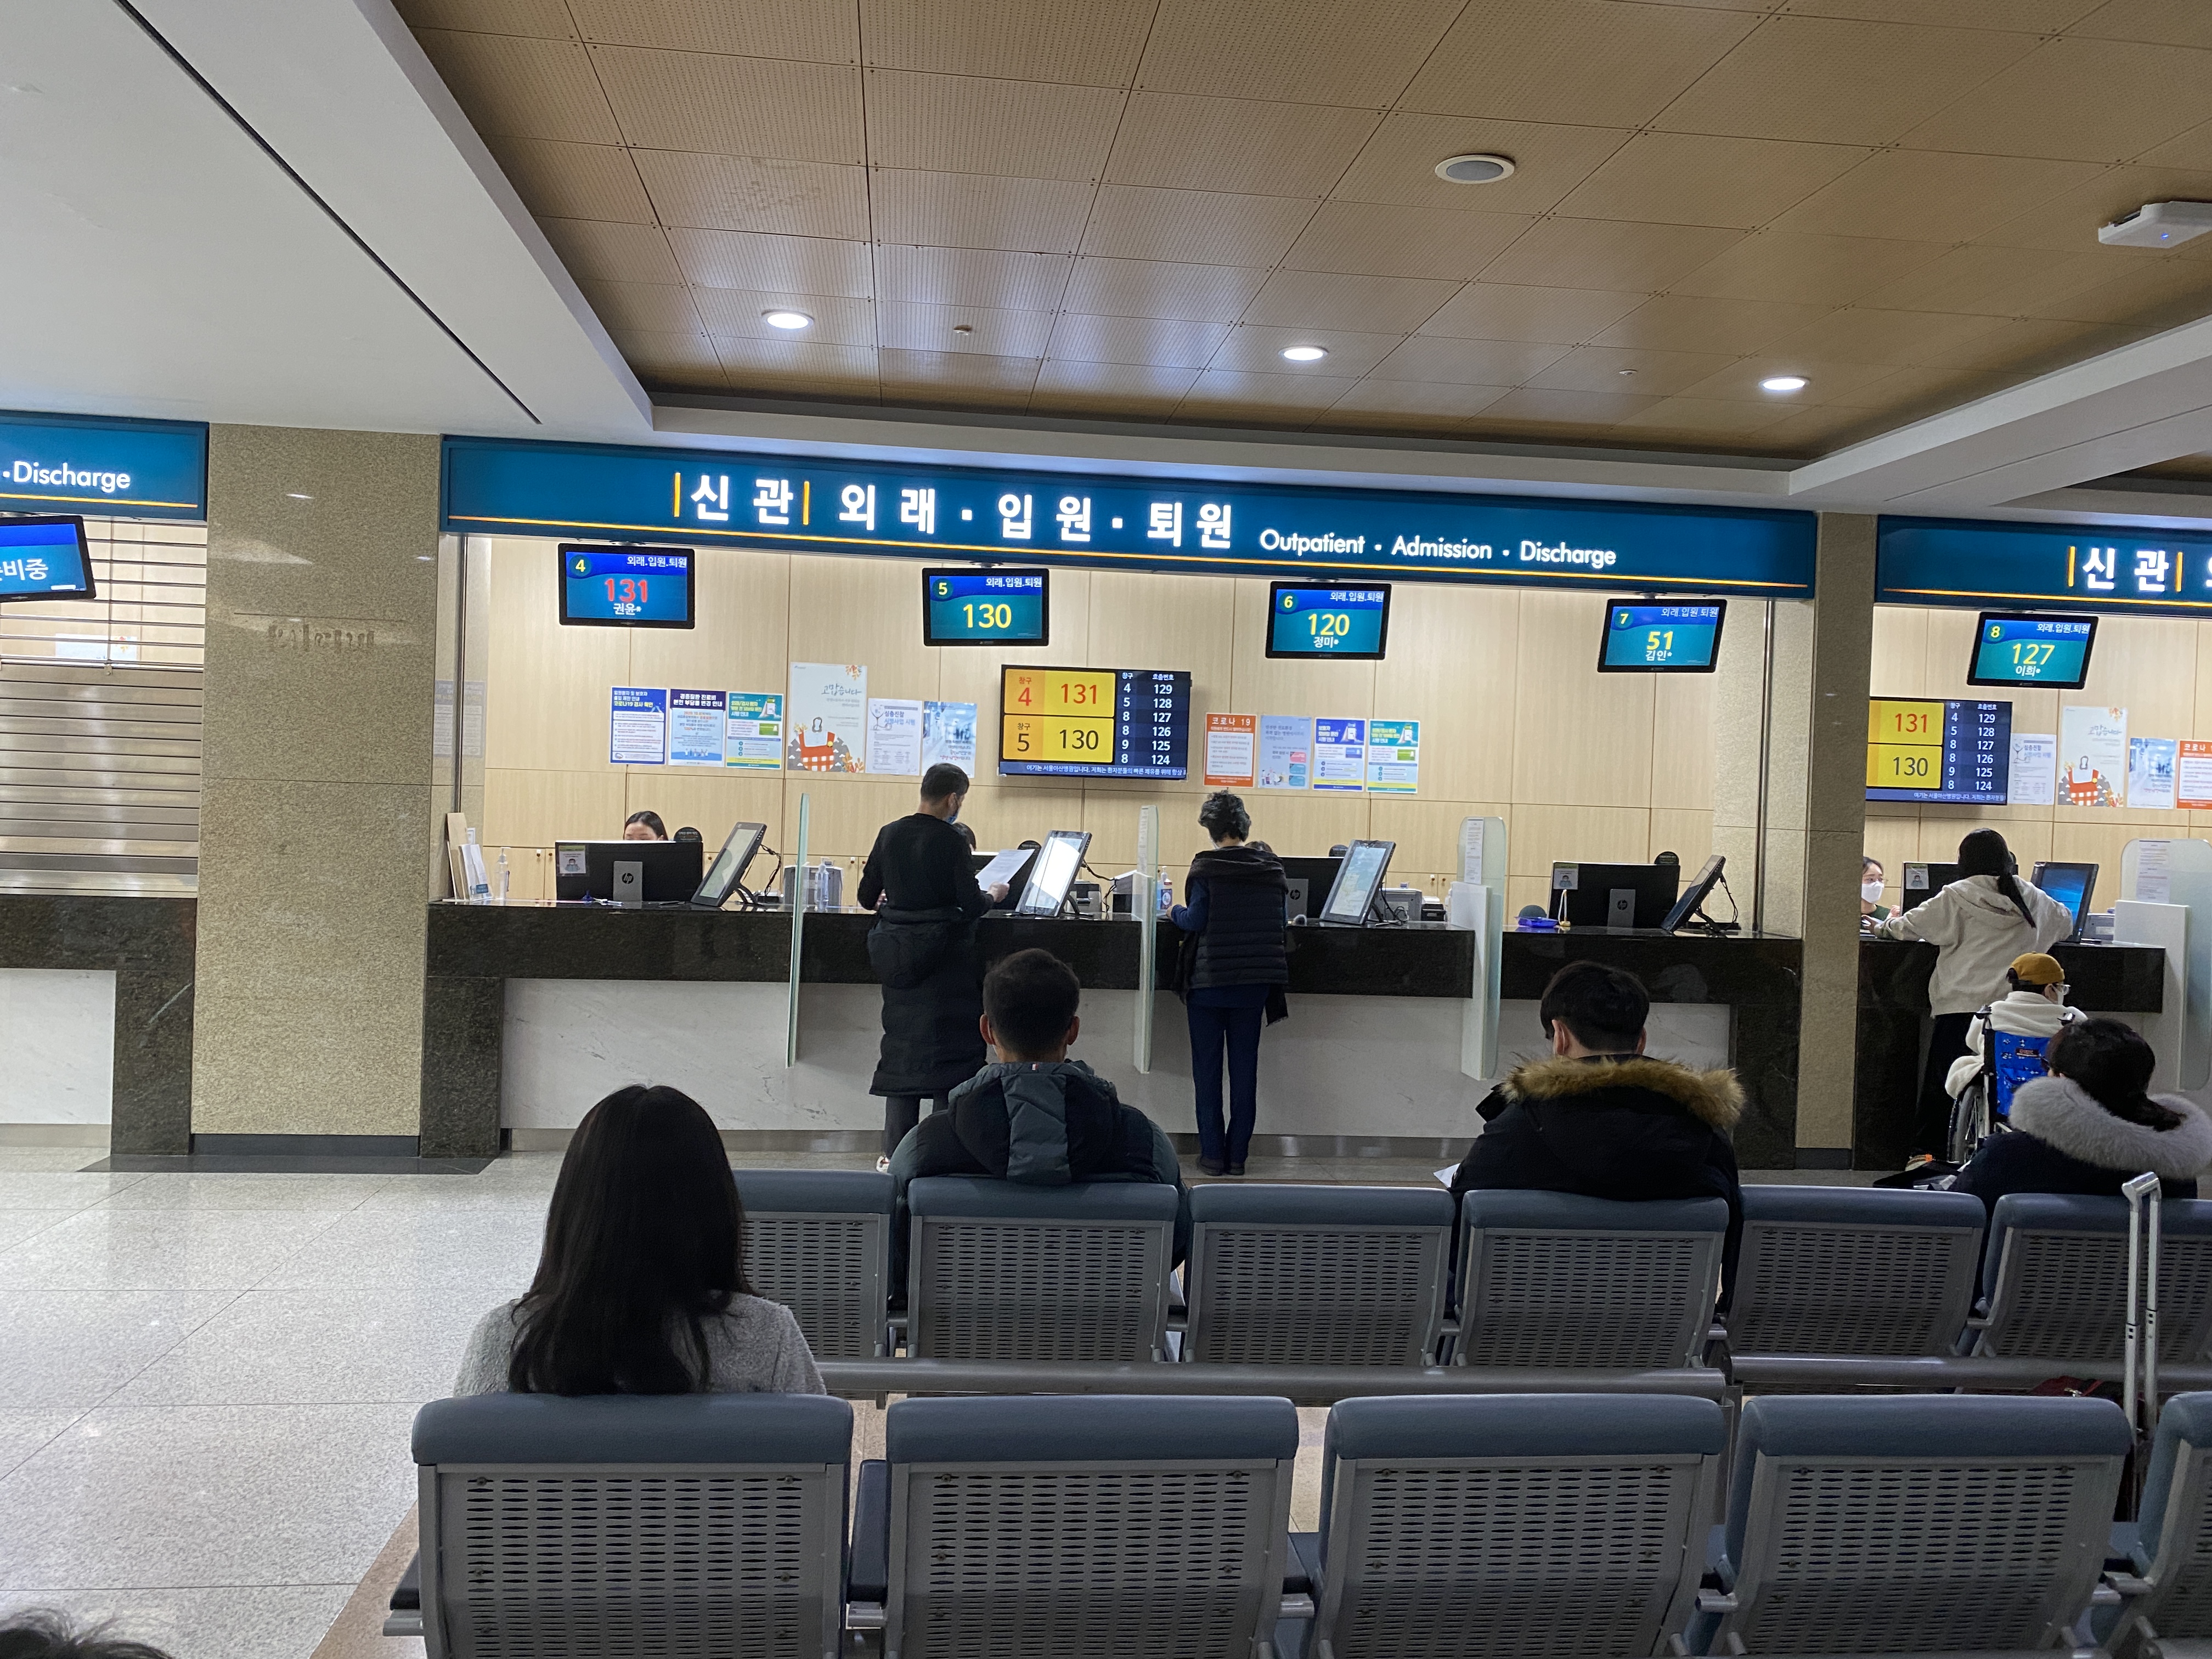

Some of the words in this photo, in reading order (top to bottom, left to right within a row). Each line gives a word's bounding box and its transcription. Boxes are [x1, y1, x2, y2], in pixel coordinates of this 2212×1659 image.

[13, 461, 131, 493] Discharge
[1260, 529, 1365, 555] Outpatient
[1391, 535, 1492, 559] Admission
[1520, 540, 1616, 569] Discharge
[0, 558, 49, 581] 비중
[575, 560, 586, 573] 4
[605, 578, 647, 603] 131
[938, 583, 948, 595] 5
[1284, 596, 1293, 608] 6
[963, 604, 1012, 629] 130
[1620, 613, 1628, 624] 7
[1308, 614, 1350, 636] 120
[1990, 627, 2000, 638] 8
[1646, 631, 1673, 650] 51
[2013, 644, 2056, 665] 127
[821, 683, 862, 696] 고맙습니다
[1018, 687, 1032, 706] 4
[1061, 684, 1097, 704] 131
[1124, 684, 1131, 693] 4
[1154, 684, 1172, 695] 129
[1123, 697, 1130, 707] 5
[1153, 698, 1172, 709] 128
[1122, 712, 1130, 721] 8
[1153, 712, 1171, 723] 127
[1212, 717, 1235, 726] 코로나
[1895, 713, 1928, 733] 131
[1951, 713, 1958, 722] 4
[1979, 714, 1995, 723] 129
[1122, 725, 1129, 735] 8
[1153, 726, 1171, 737] 126
[1951, 726, 1957, 735] 5
[1978, 727, 1995, 737] 128
[1017, 733, 1029, 752] 5
[1060, 729, 1099, 750] 130
[1122, 740, 1128, 749] 9
[1152, 741, 1170, 751] 125
[1950, 740, 1956, 749] 8
[1977, 741, 1994, 750] 127
[2184, 743, 2206, 752] 코로나
[1121, 754, 1128, 763] 8
[1152, 754, 1170, 765] 124
[1949, 753, 1956, 763] 8
[1977, 754, 1993, 764] 126
[1893, 757, 1928, 777] 130
[1949, 767, 1955, 776] 9
[1976, 768, 1993, 777] 125
[1948, 780, 1954, 789] 8
[1976, 781, 1992, 791] 124
